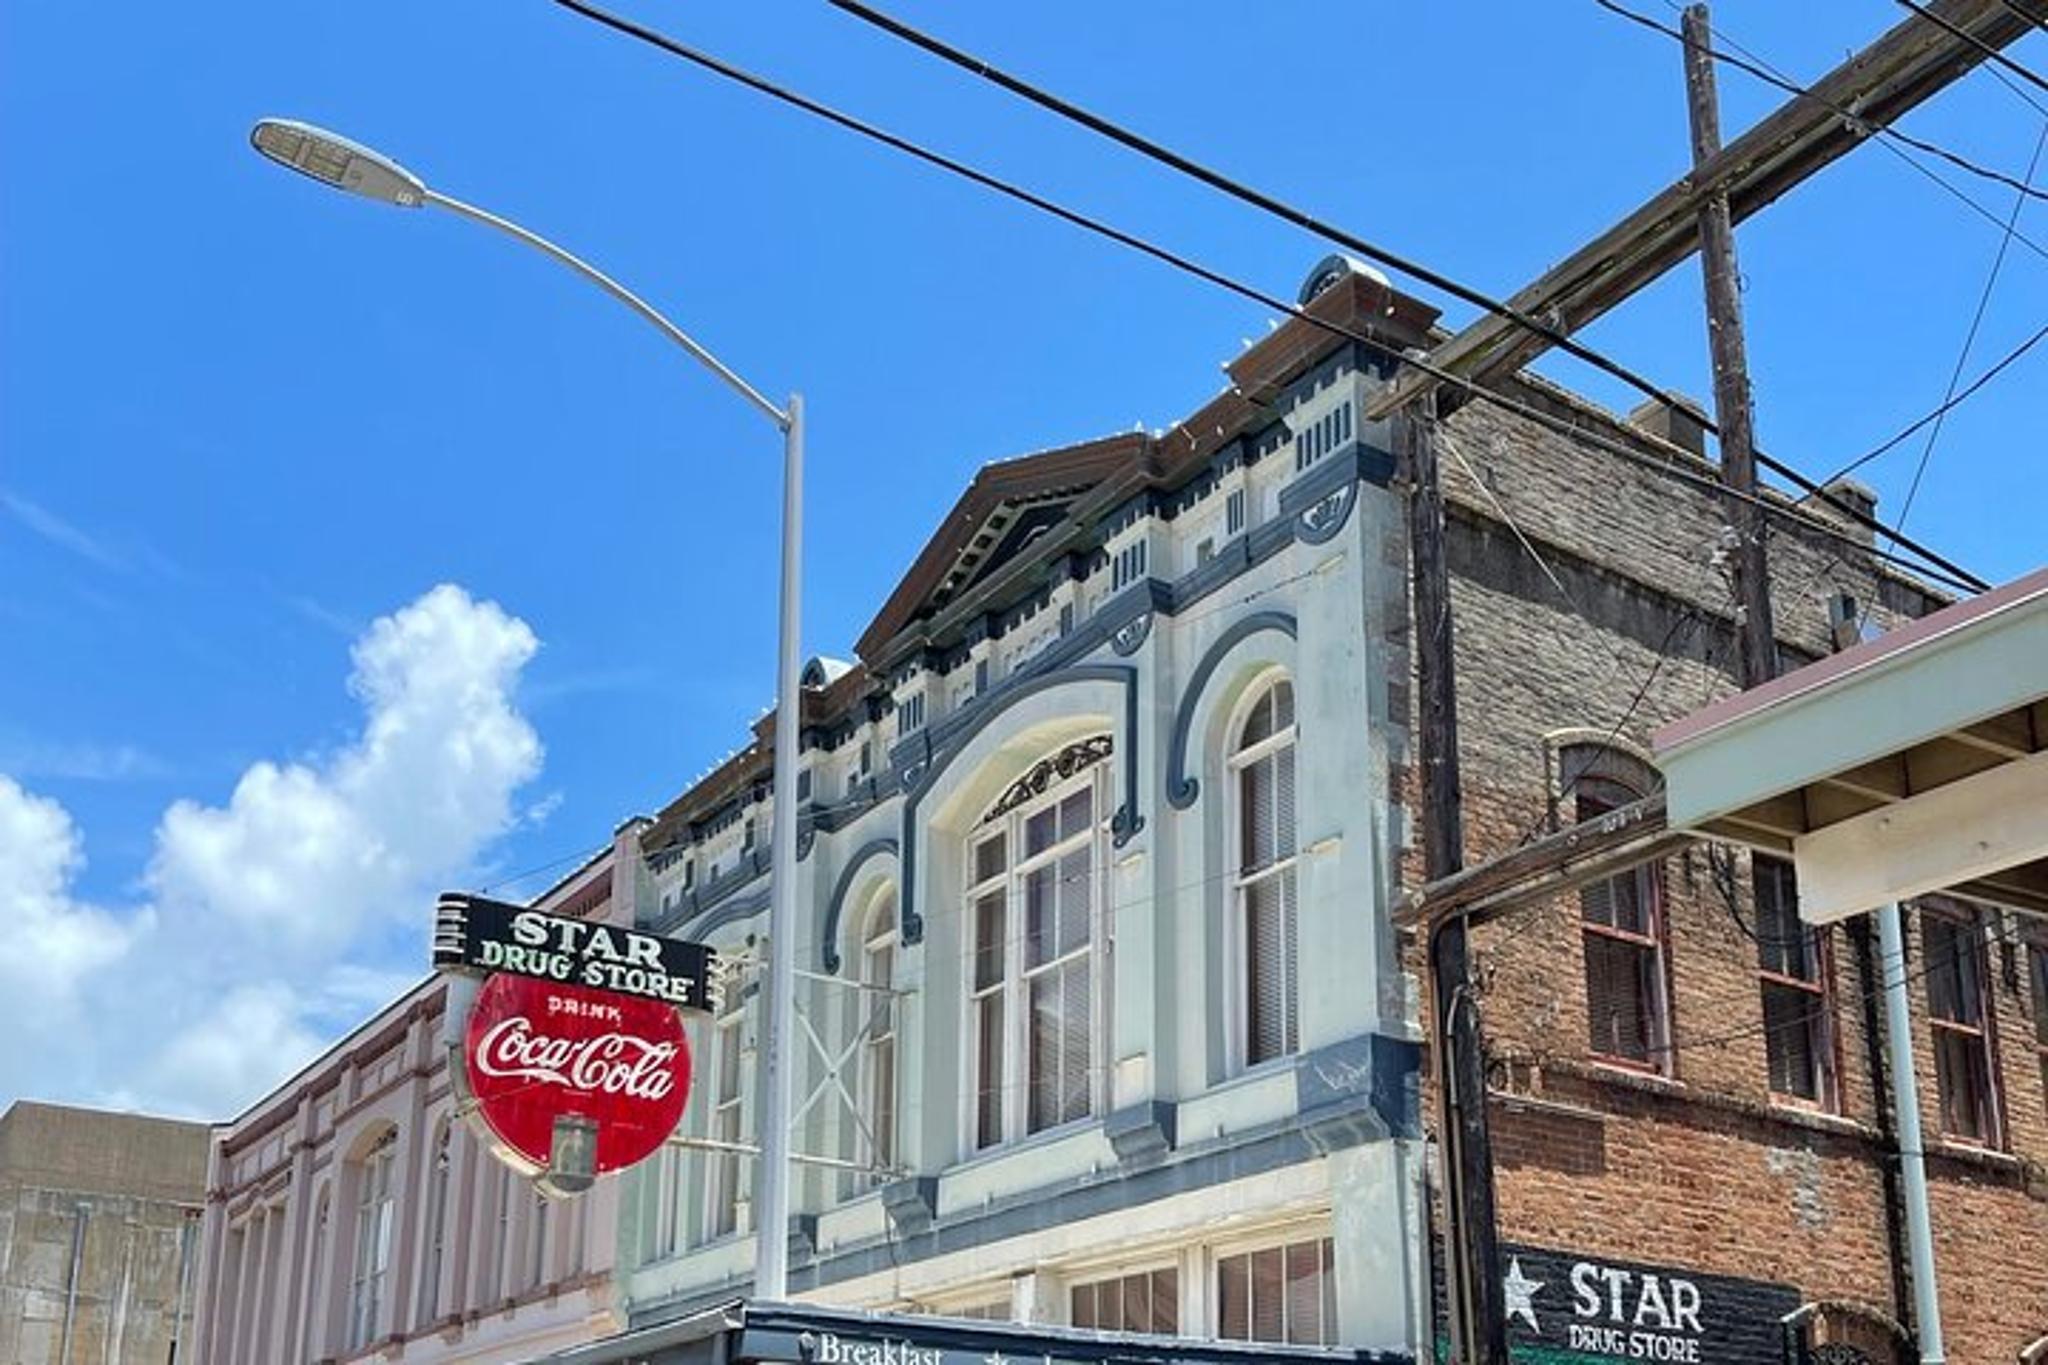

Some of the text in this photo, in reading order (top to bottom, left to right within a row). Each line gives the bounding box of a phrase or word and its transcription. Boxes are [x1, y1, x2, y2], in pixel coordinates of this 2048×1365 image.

[481, 940, 694, 1002] DRUG STORE
[510, 912, 666, 973] STAR
[547, 996, 622, 1021] DRINK
[1570, 1262, 1705, 1333] STAR
[1569, 1324, 1700, 1363] DRUG STORE
